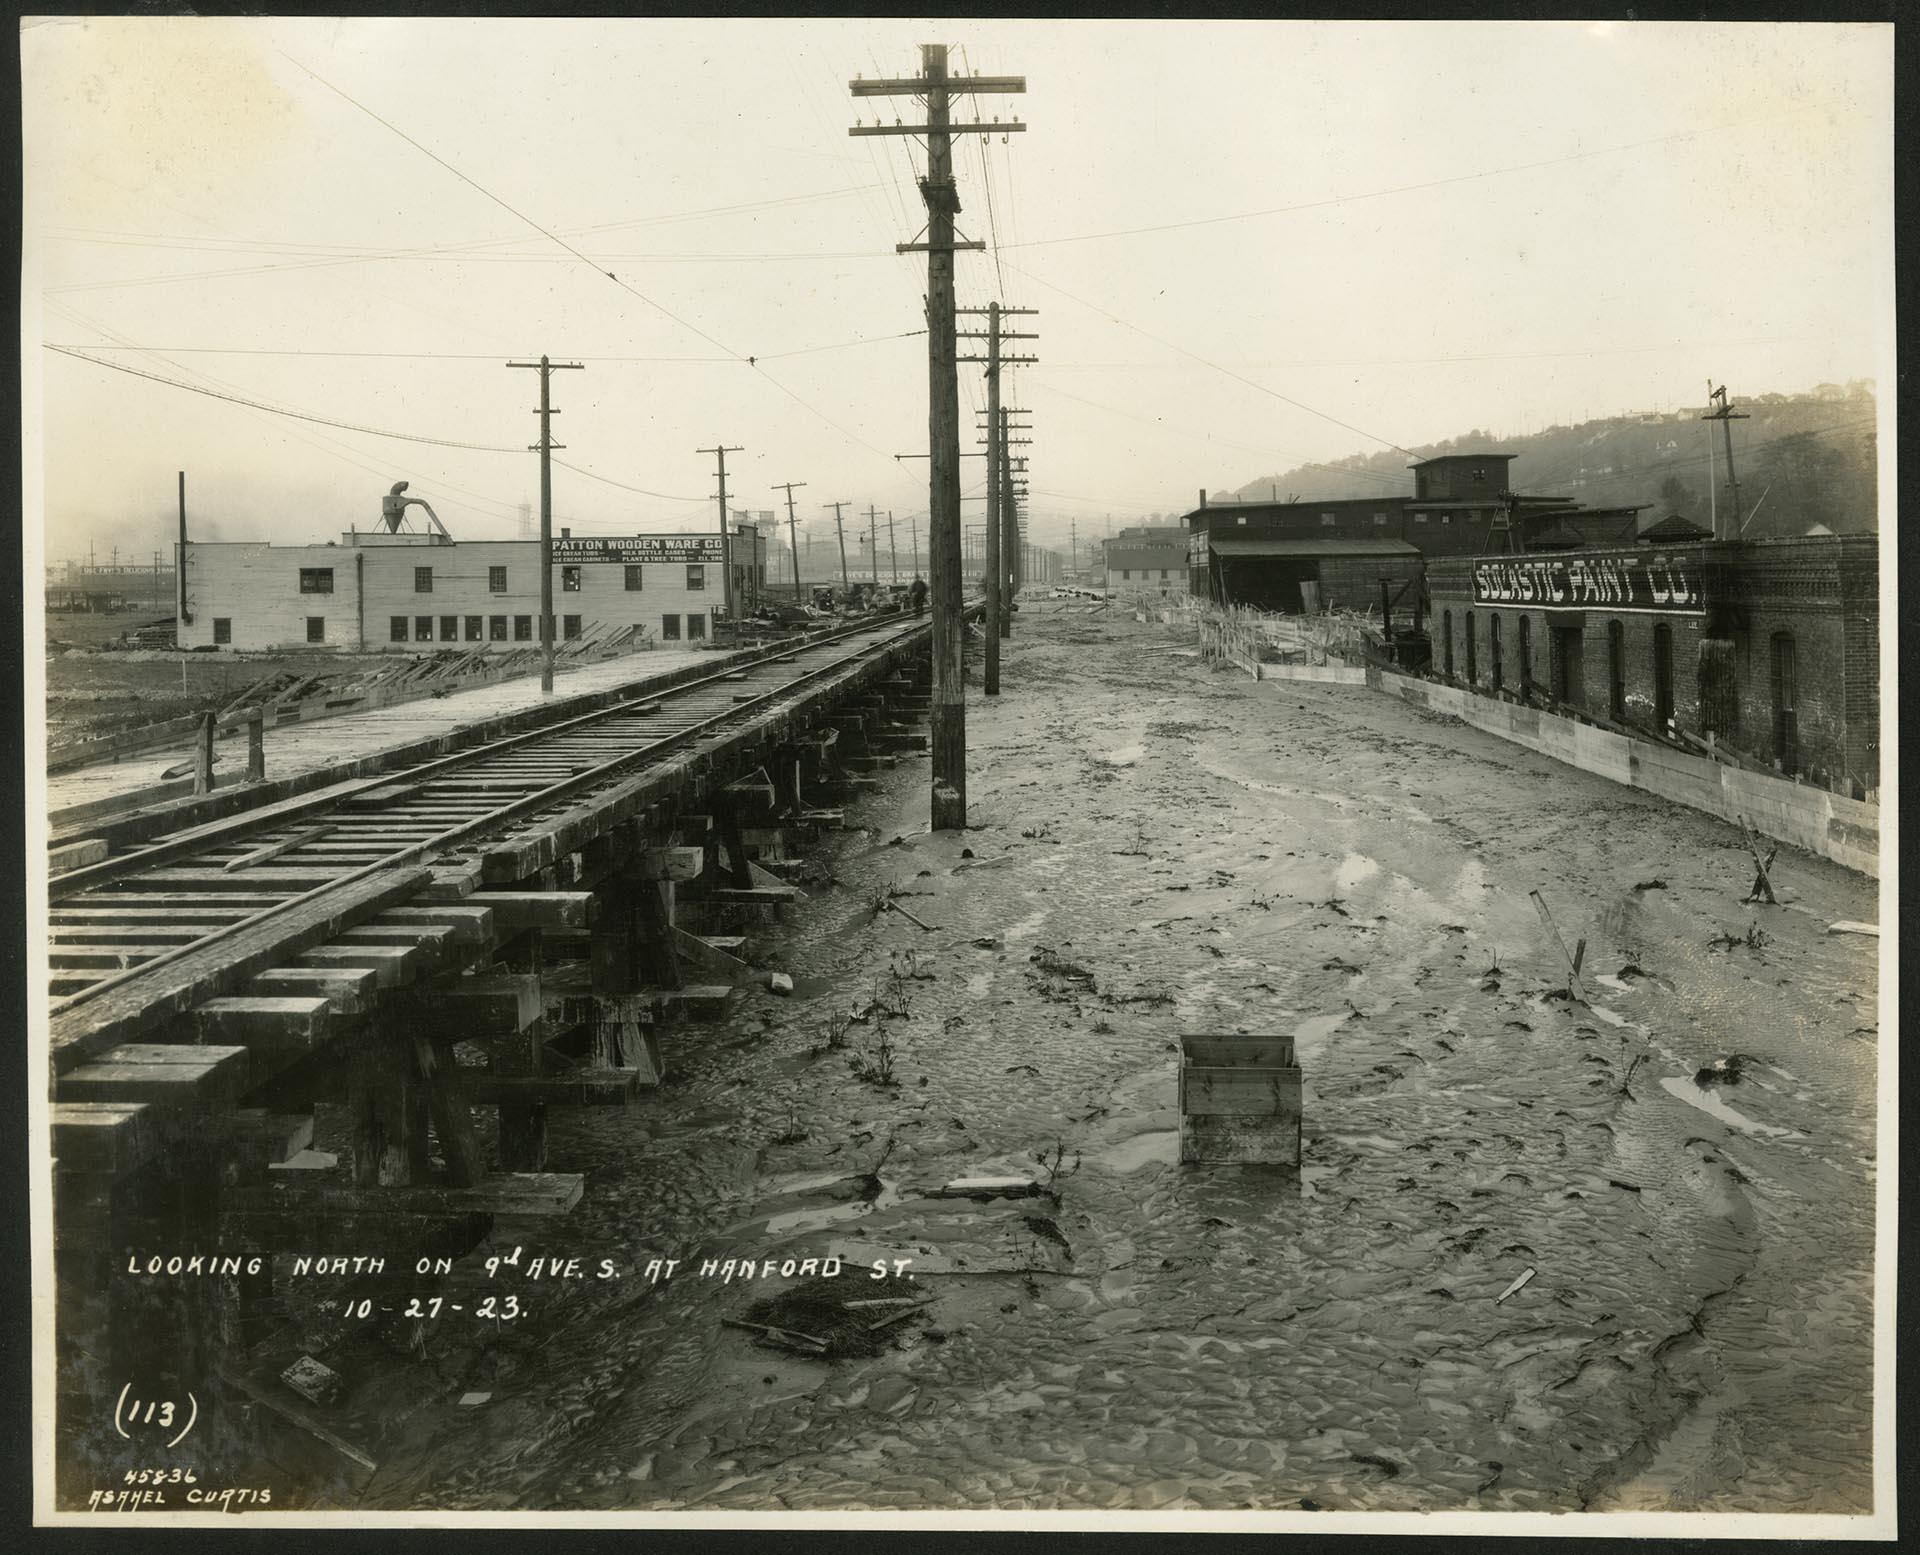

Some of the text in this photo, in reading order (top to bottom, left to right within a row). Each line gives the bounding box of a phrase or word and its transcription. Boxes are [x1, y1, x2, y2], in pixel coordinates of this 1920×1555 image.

[552, 539, 722, 550] PATTON WOODEN WARE CO
[1568, 557, 1639, 602] PAINT
[1647, 556, 1697, 604] CO.
